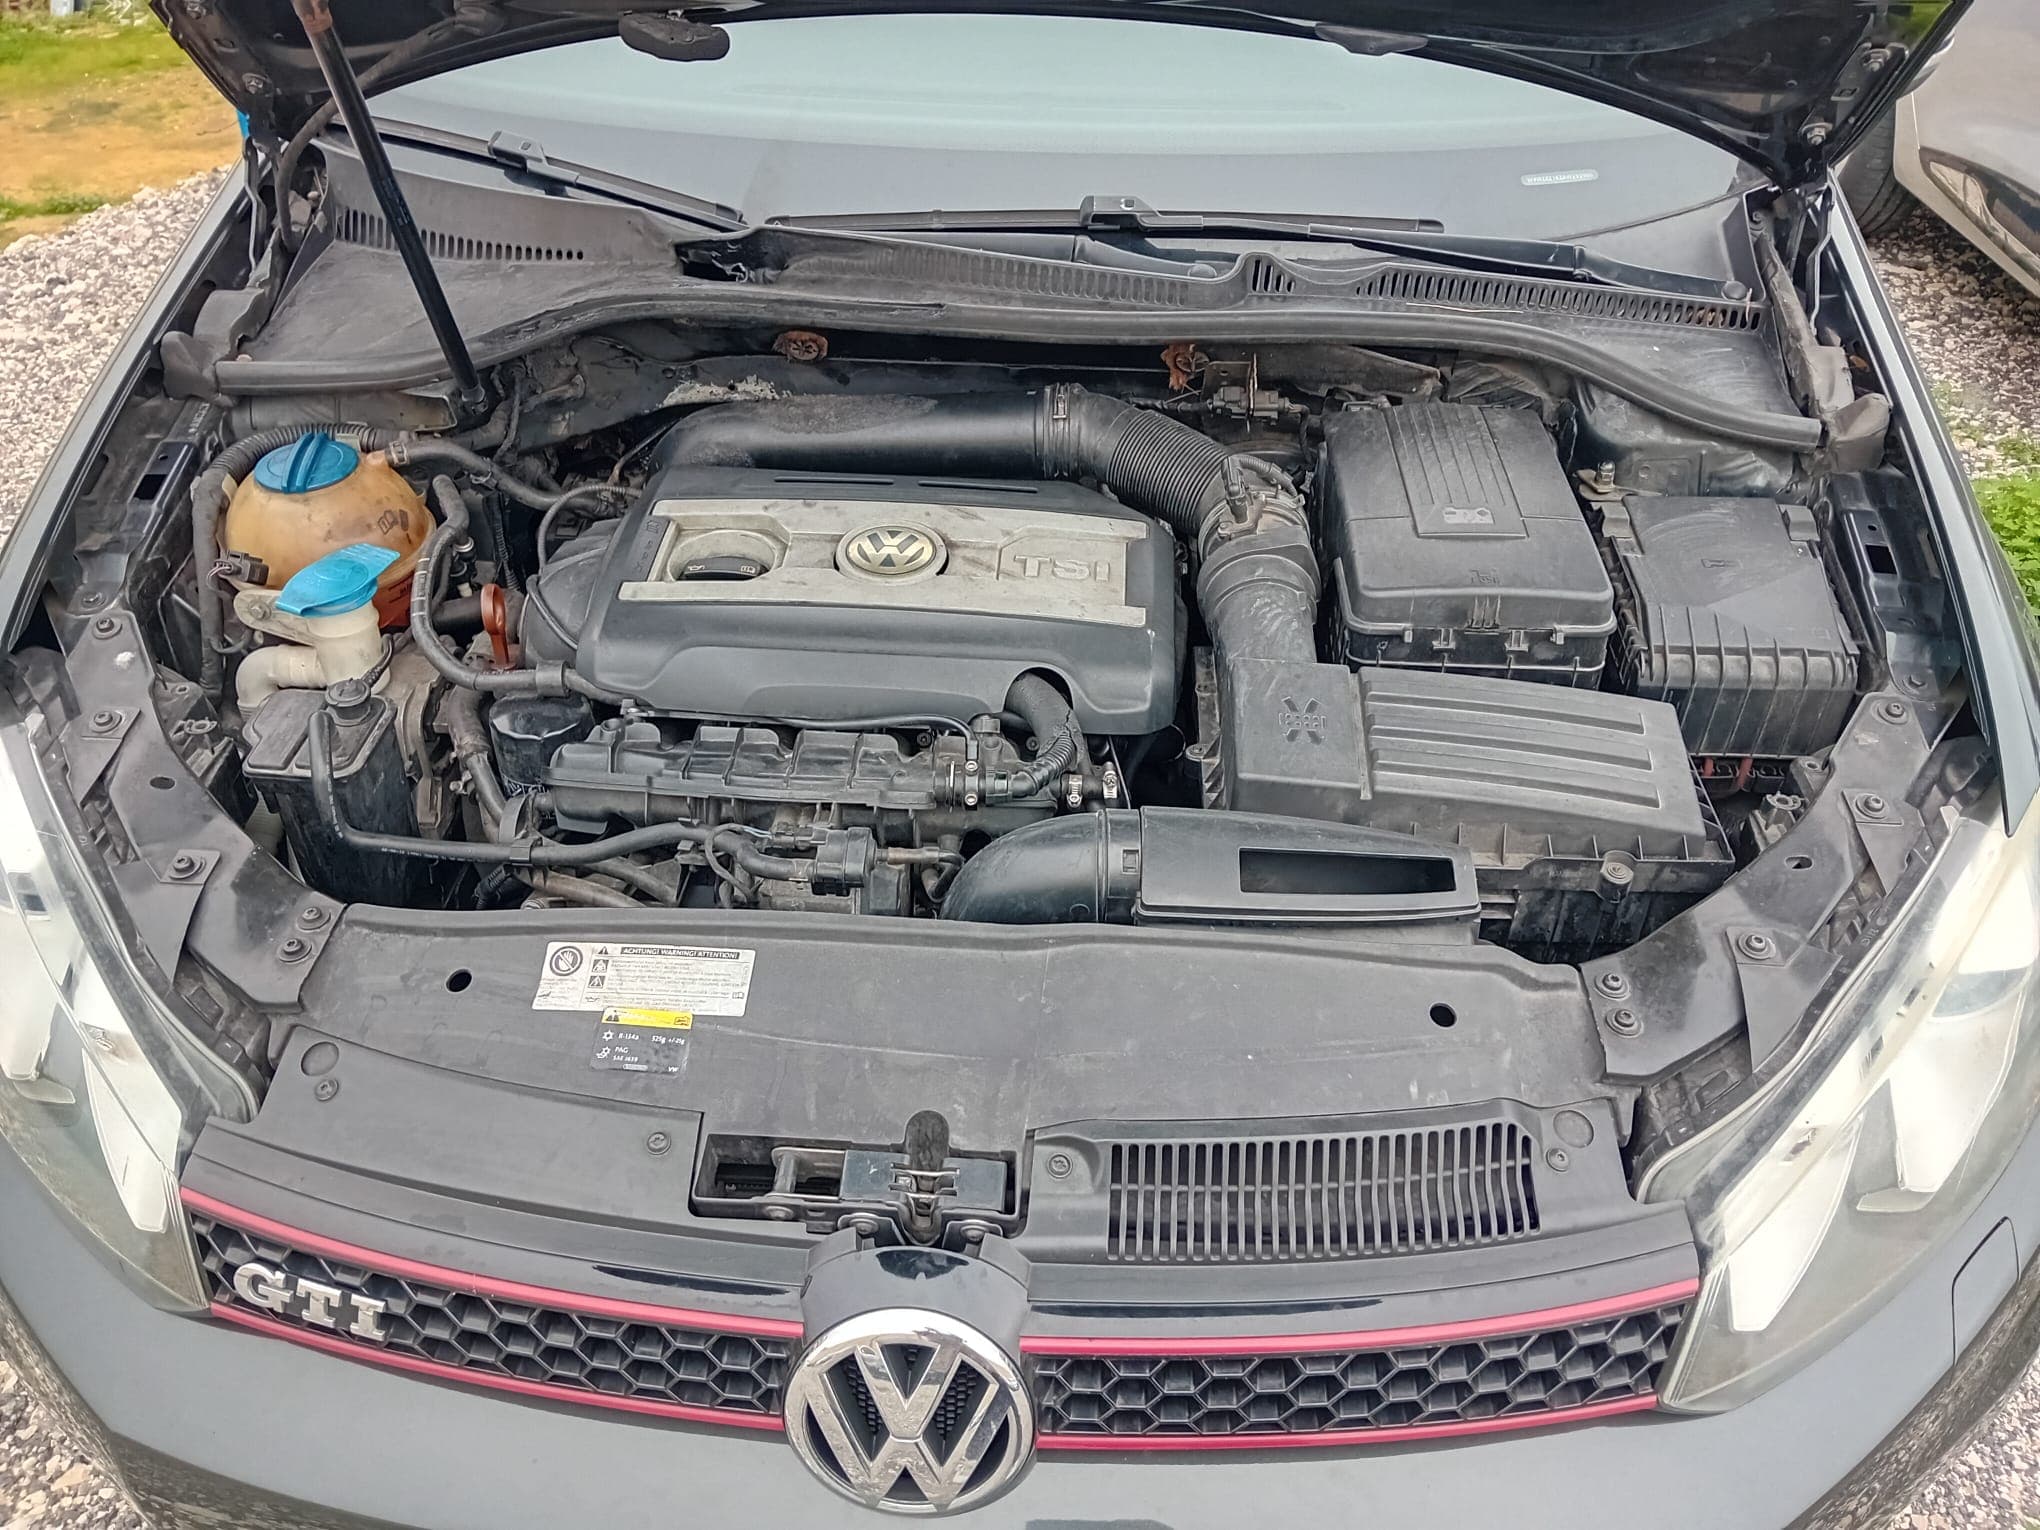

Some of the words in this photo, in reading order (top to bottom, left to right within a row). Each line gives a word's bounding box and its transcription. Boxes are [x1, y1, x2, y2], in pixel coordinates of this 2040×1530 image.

[846, 526, 936, 575] VW
[1013, 554, 1110, 581] TSI
[623, 946, 659, 955] ACHTUNG!
[661, 948, 697, 958] WARNING!
[698, 951, 739, 960] ATTENTION!
[614, 1046, 629, 1054] PAG
[233, 1262, 388, 1342] GTI
[786, 1307, 1034, 1516] VW
